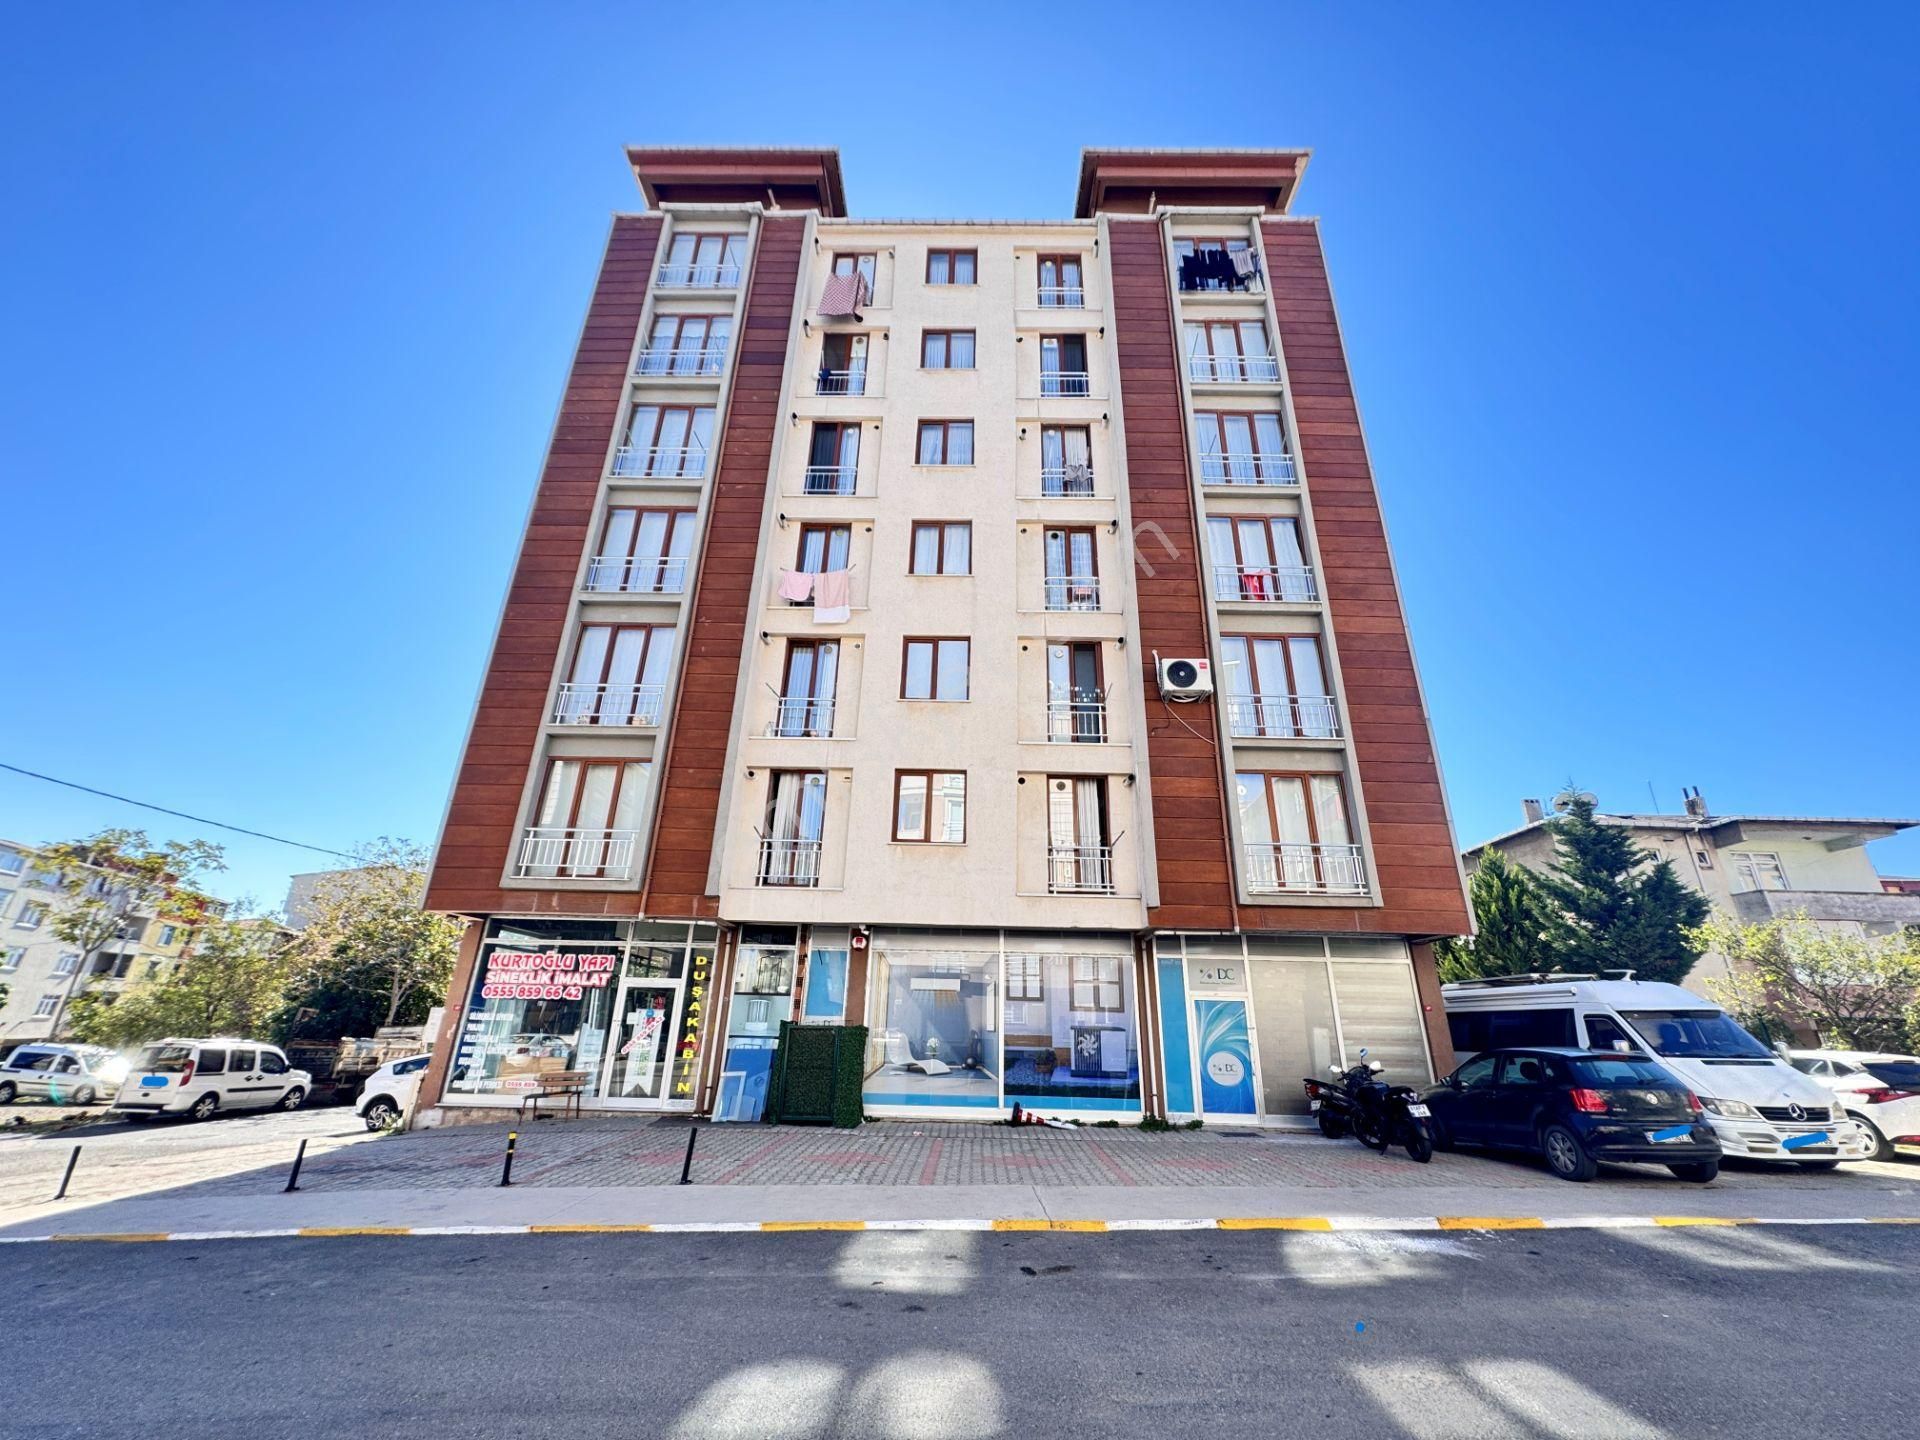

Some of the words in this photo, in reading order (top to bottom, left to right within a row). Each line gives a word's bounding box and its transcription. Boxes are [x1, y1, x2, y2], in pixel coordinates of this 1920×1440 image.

[488, 951, 575, 970] KURTOĞLU
[579, 954, 616, 971] YAPI
[485, 970, 551, 985] SİNEKLİK
[554, 971, 612, 987] İMALAT
[1217, 968, 1235, 980] DC
[482, 985, 515, 999] 0555
[516, 985, 542, 999] 859
[544, 986, 562, 999] 66
[563, 986, 582, 999] 42
